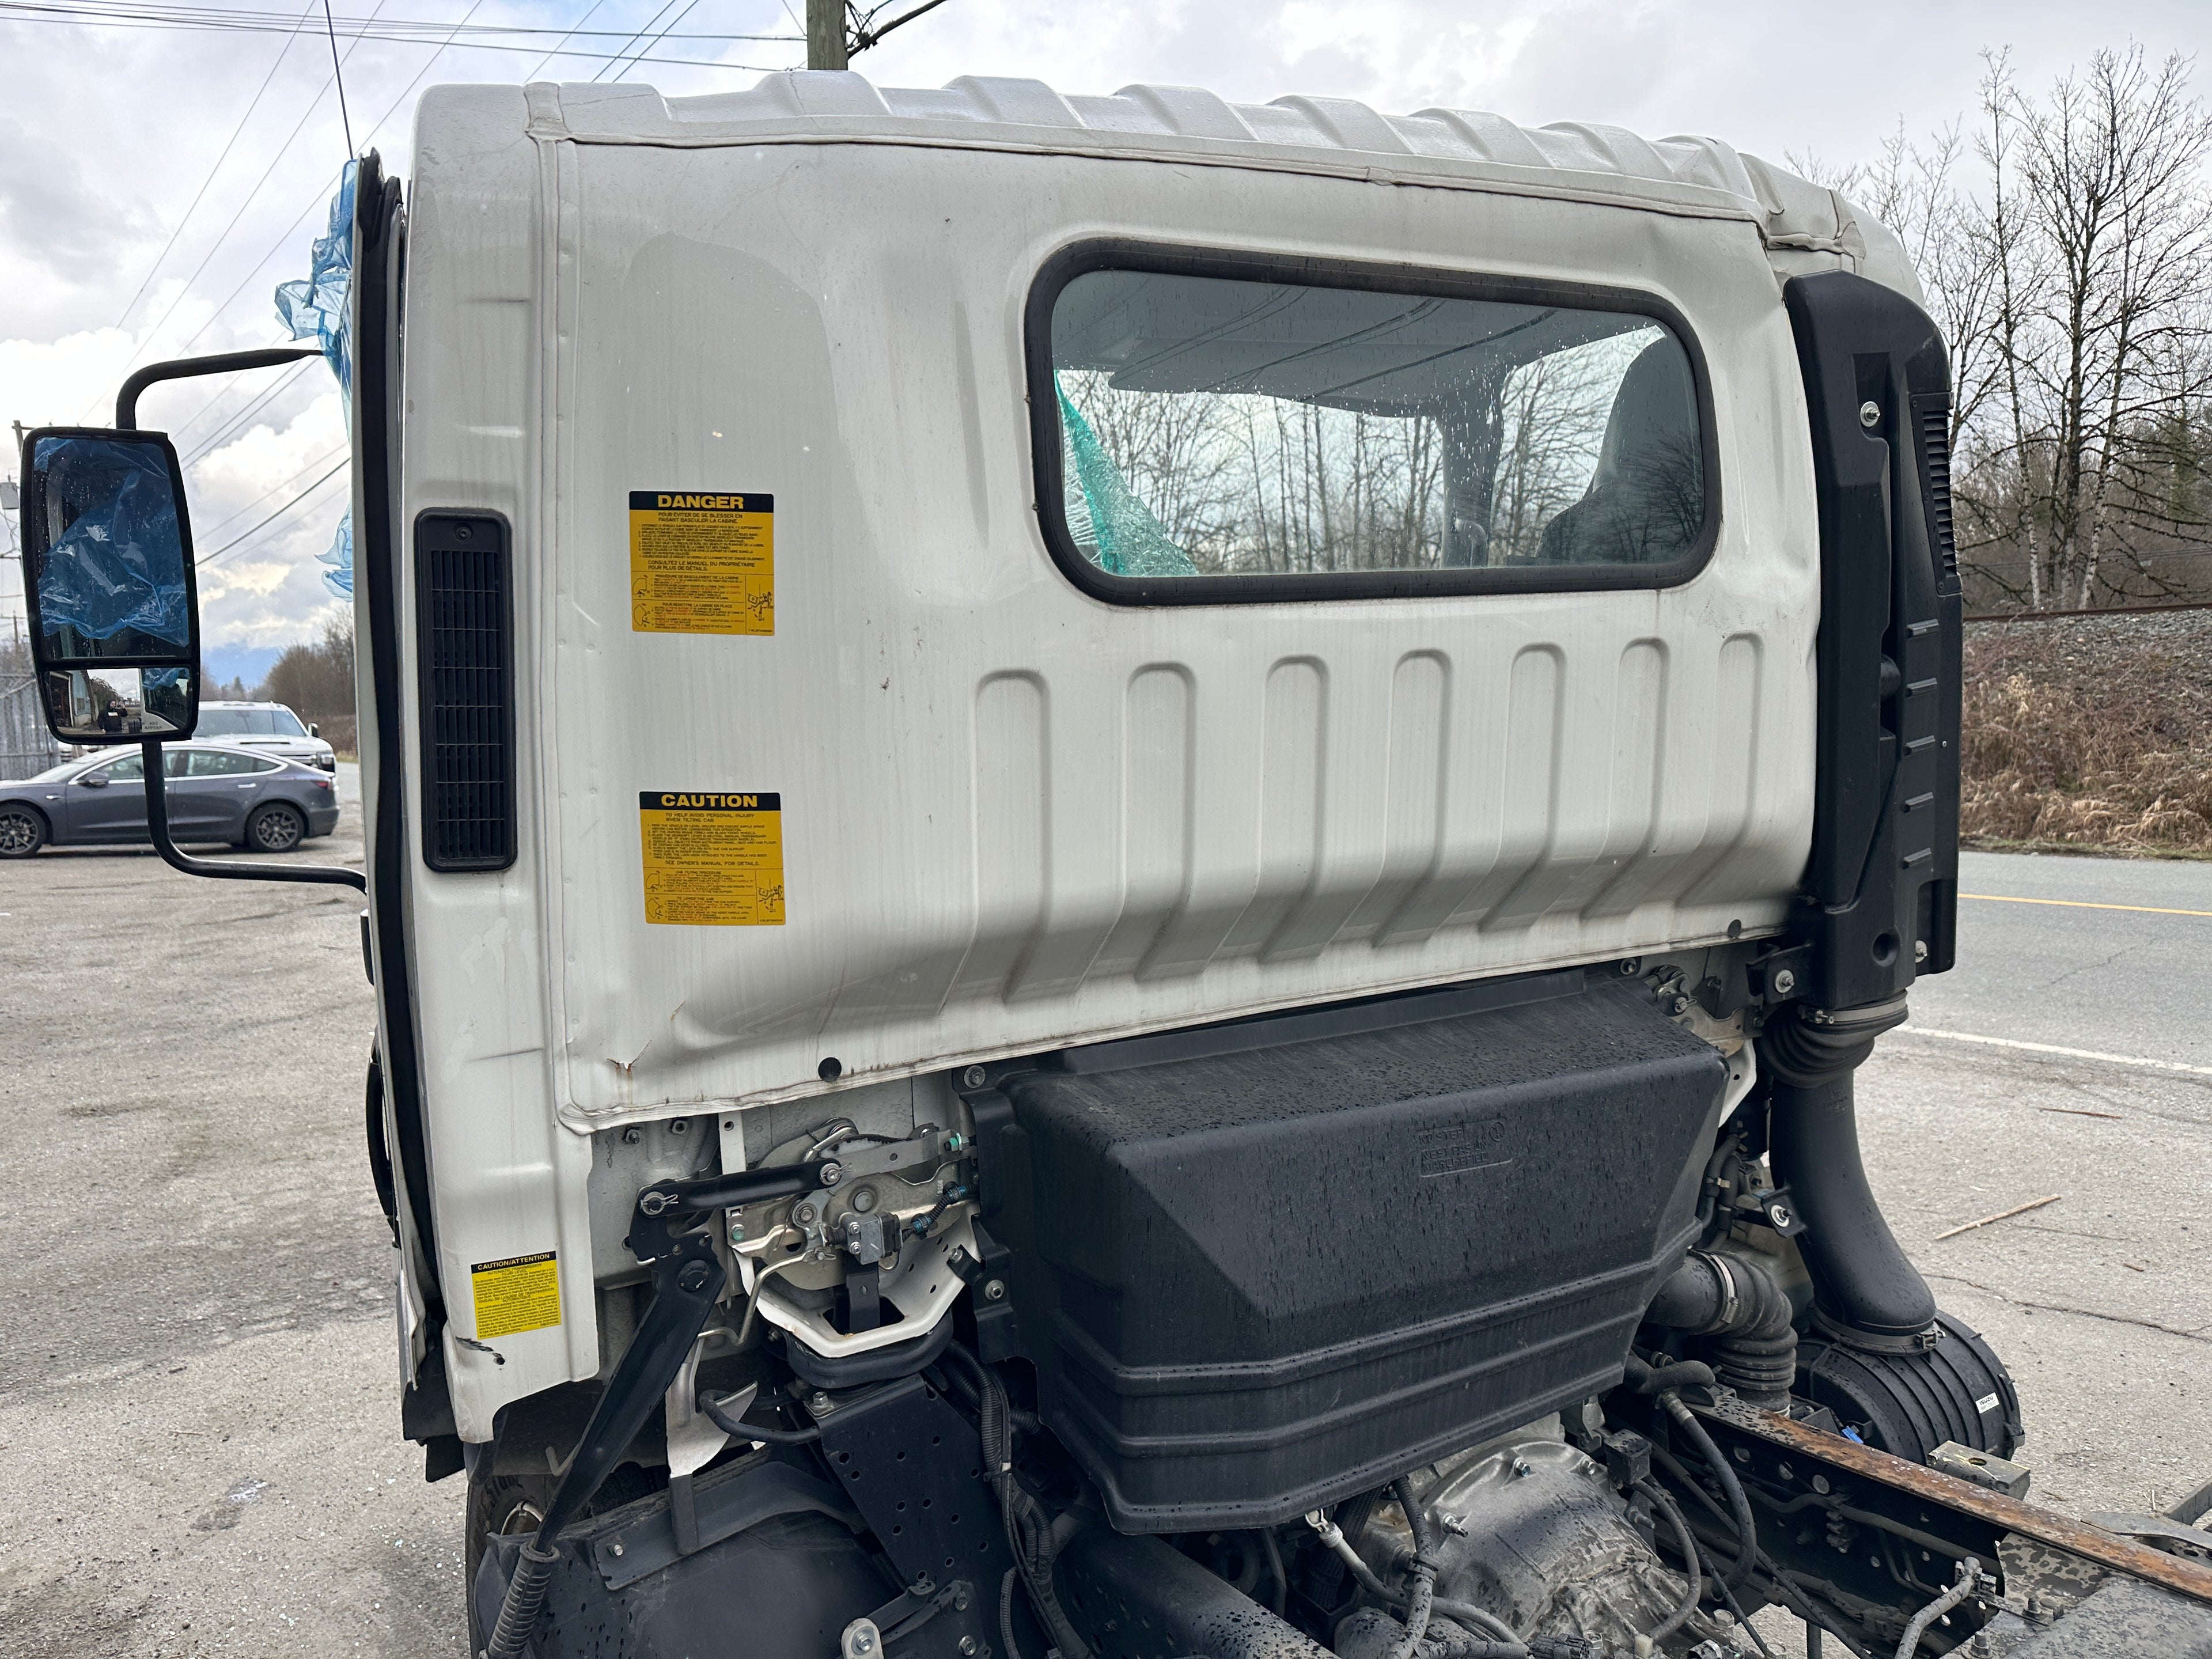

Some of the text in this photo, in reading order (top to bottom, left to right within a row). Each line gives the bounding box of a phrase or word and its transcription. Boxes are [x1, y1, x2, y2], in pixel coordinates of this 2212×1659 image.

[658, 494, 744, 509] DANGER
[661, 794, 757, 807] CAUTION
[1435, 1128, 1464, 1141] STEP
[478, 1253, 550, 1270] CAUTION/ATTENTION
[1979, 1396, 1994, 1405] ISUZU
